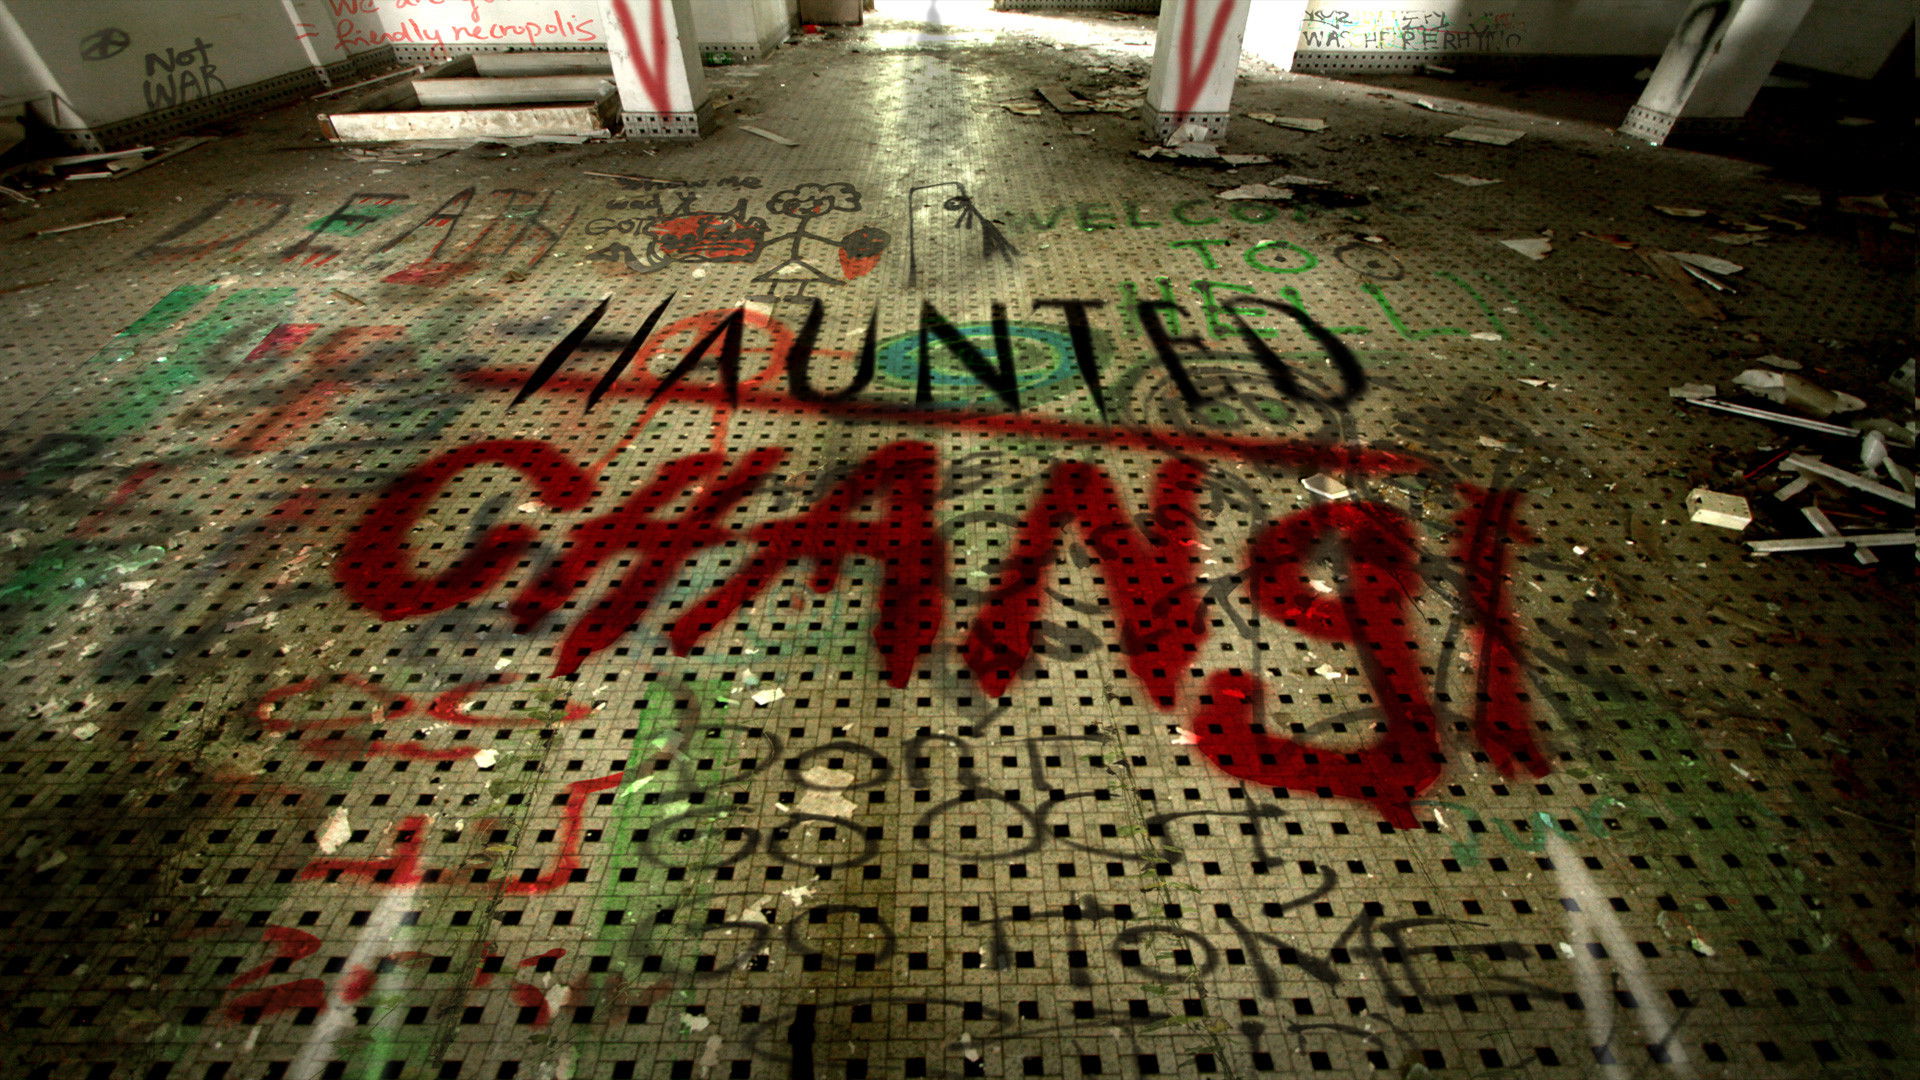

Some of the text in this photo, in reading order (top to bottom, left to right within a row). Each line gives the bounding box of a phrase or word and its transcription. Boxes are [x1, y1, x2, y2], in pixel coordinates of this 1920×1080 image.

[335, 18, 448, 58] friendly
[452, 10, 597, 45] necropolis
[143, 64, 228, 111] WAR
[1169, 237, 1319, 276] TO
[508, 290, 1367, 416] HAUNTED
